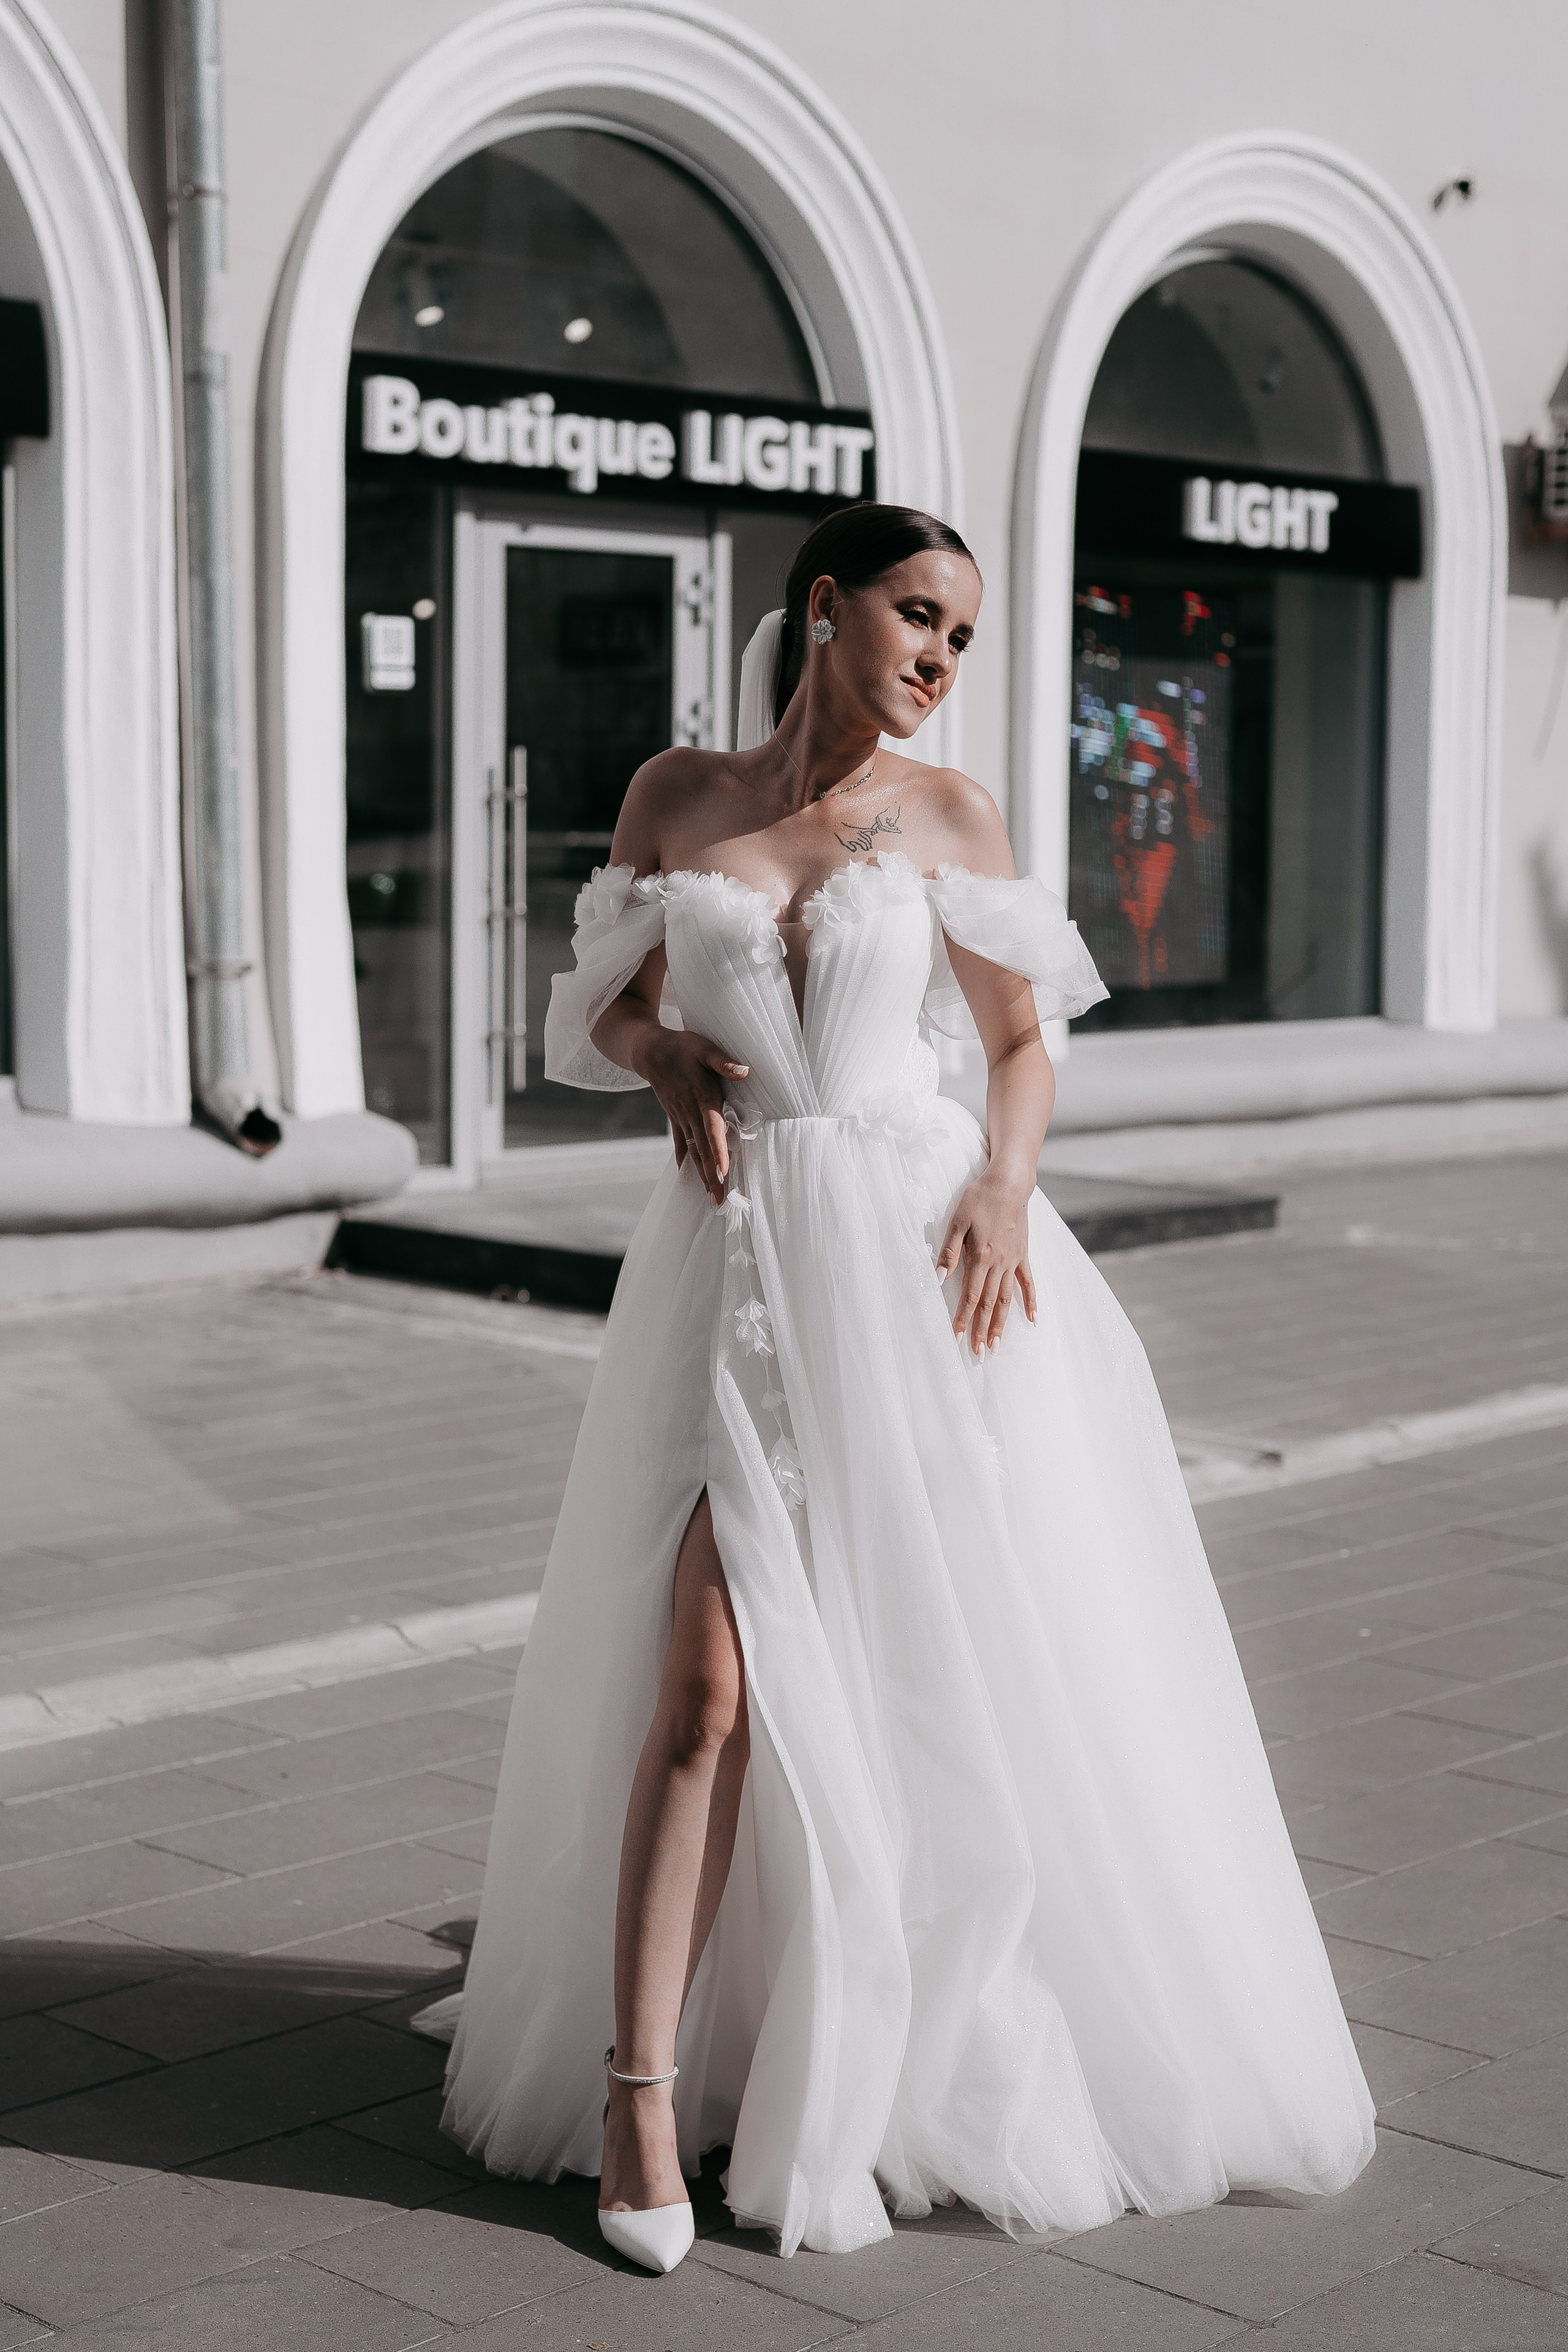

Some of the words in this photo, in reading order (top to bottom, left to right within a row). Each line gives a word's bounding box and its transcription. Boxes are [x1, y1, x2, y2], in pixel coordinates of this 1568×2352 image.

[363, 374, 676, 494] Boutique
[681, 410, 874, 497] LIGHT
[1182, 476, 1339, 553] LIGHT
